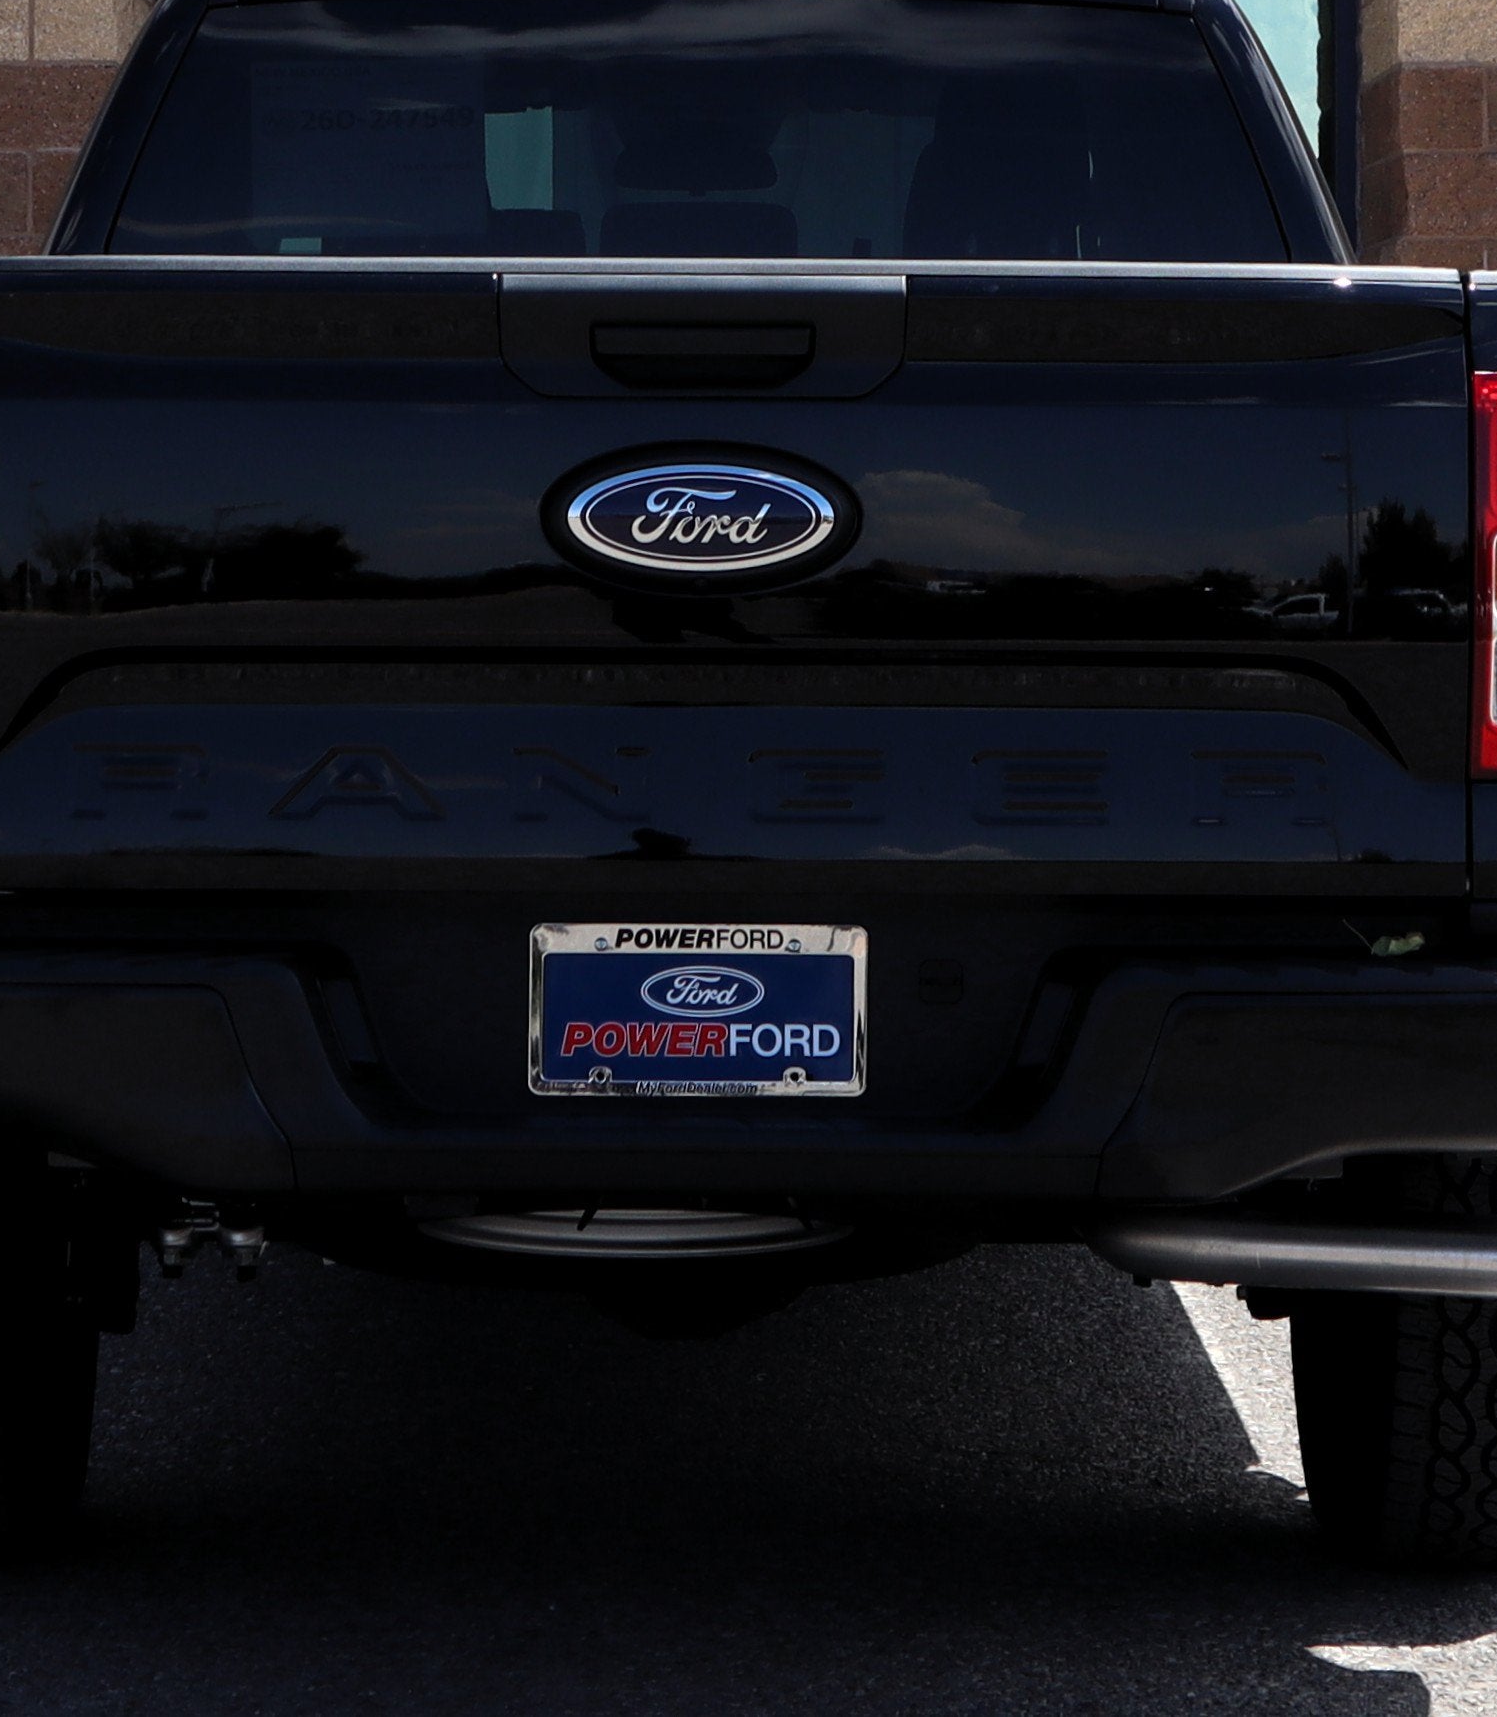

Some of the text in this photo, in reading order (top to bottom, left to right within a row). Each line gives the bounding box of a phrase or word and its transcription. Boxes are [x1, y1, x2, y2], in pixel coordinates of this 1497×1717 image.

[631, 486, 772, 544] Ford
[69, 741, 1340, 826] RANGER
[614, 928, 785, 950] POWERFORD
[666, 974, 738, 1005] Ford
[560, 1021, 842, 1058] POWERFORD
